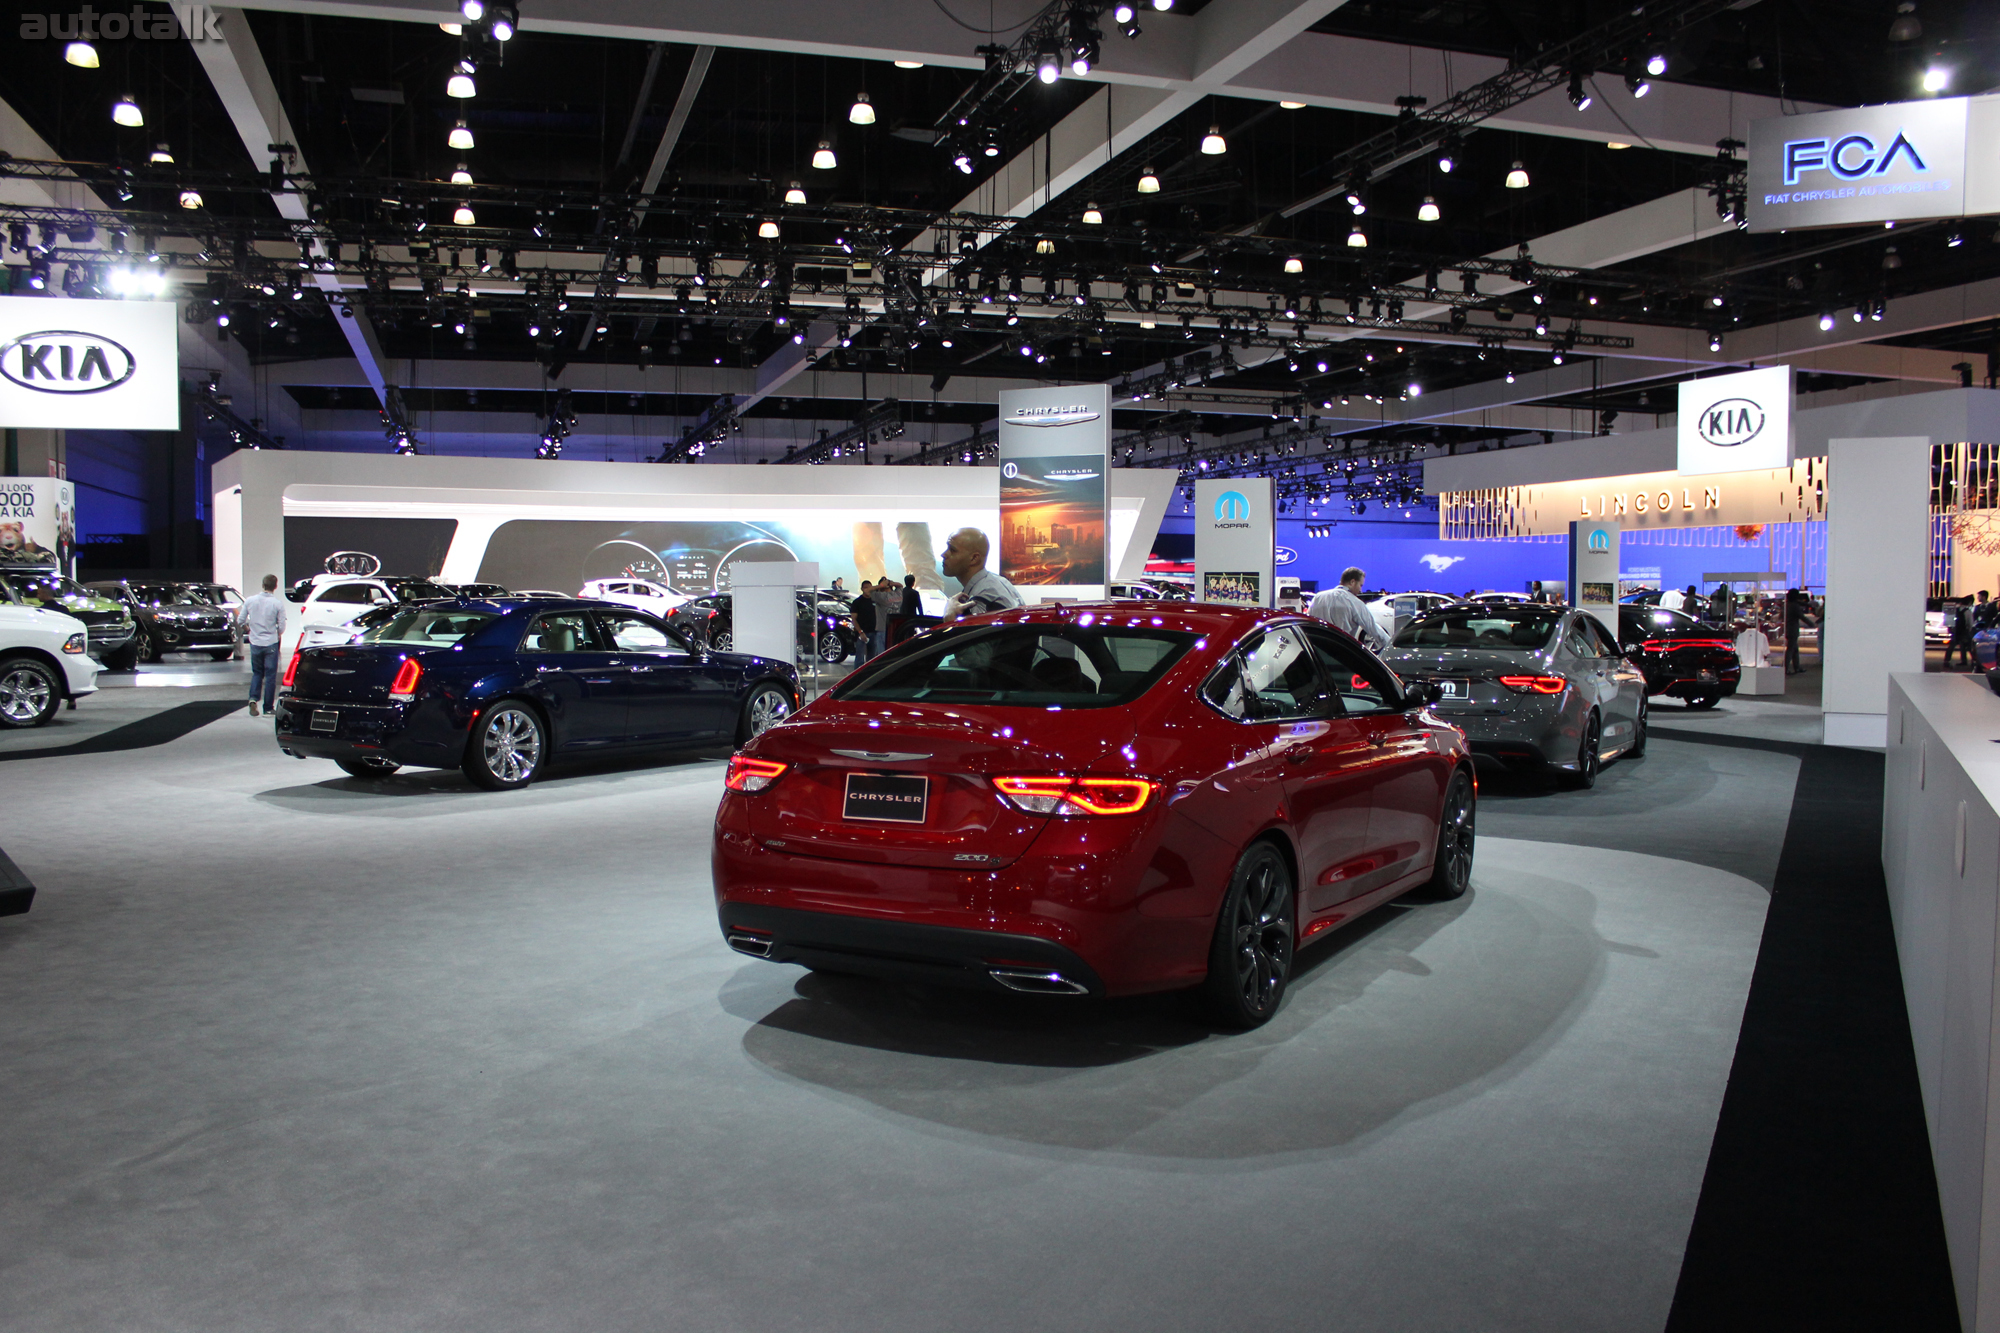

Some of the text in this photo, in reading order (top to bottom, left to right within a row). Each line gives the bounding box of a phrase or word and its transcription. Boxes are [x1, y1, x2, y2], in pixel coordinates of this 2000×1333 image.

[1784, 128, 1929, 185] FCA
[1765, 179, 1950, 205] FIAT CHRYSLER AUTOMOBILES
[20, 344, 115, 382] KIA
[1016, 405, 1088, 416] CHRYSLER
[1709, 408, 1753, 437] KIA
[7, 483, 34, 492] LOOK
[1580, 486, 1721, 517] LINCOLN
[1, 507, 35, 518] A KIA
[334, 557, 372, 573] KIA
[849, 792, 922, 803] CHRYSLER
[953, 854, 989, 862] 200
